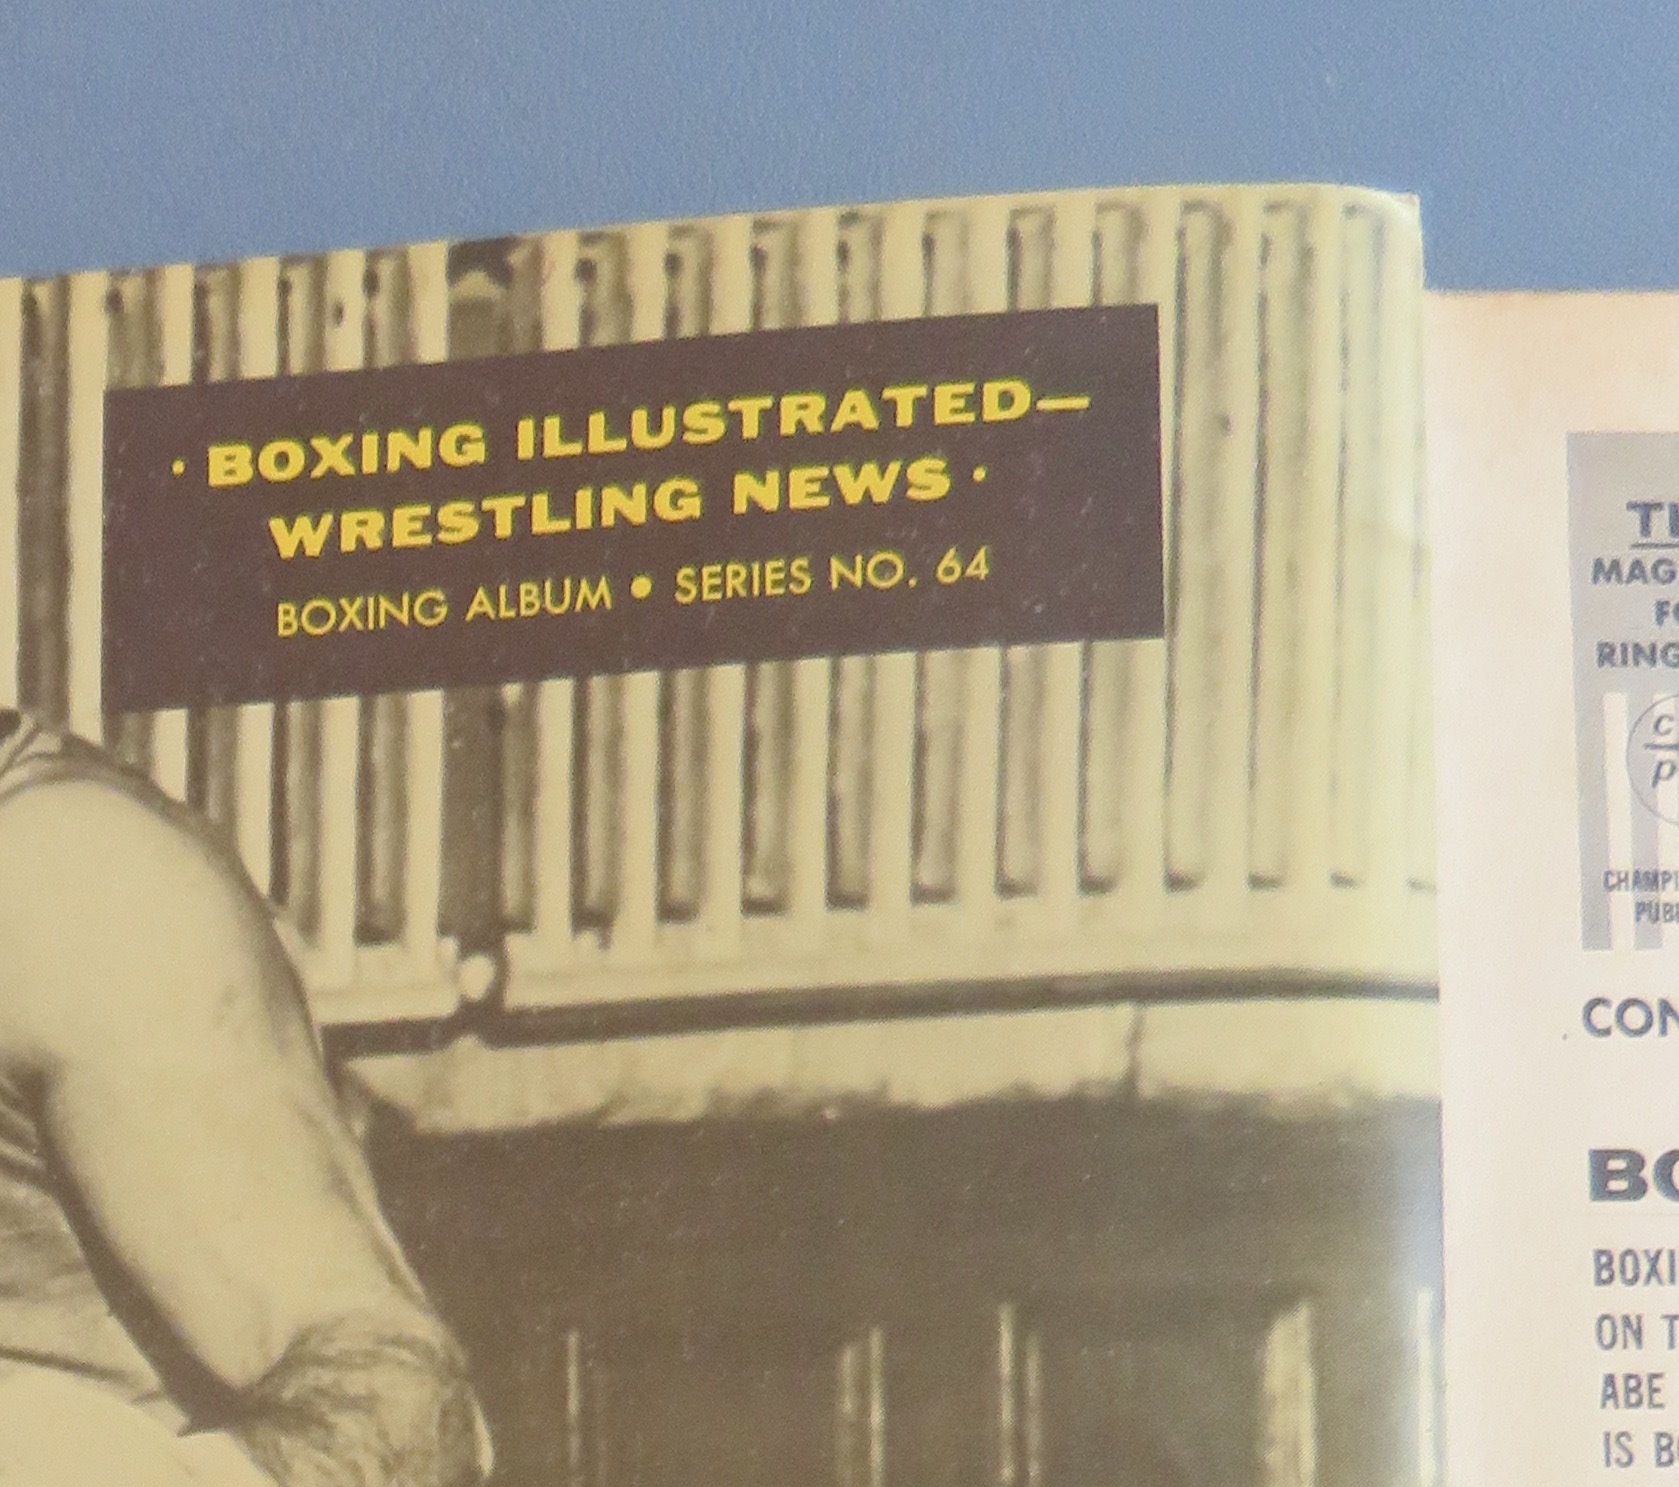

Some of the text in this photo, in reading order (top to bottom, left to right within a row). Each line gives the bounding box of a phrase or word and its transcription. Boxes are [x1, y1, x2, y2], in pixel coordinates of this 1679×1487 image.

[206, 419, 489, 489] BOXING
[267, 452, 954, 560] WRESTLING NEWS
[277, 543, 993, 638] BOXING ALBUM SERIES NO. 64
[1596, 1313, 1643, 1351] ON
[1601, 1372, 1666, 1409] ABE
[1604, 1431, 1634, 1468] IS
